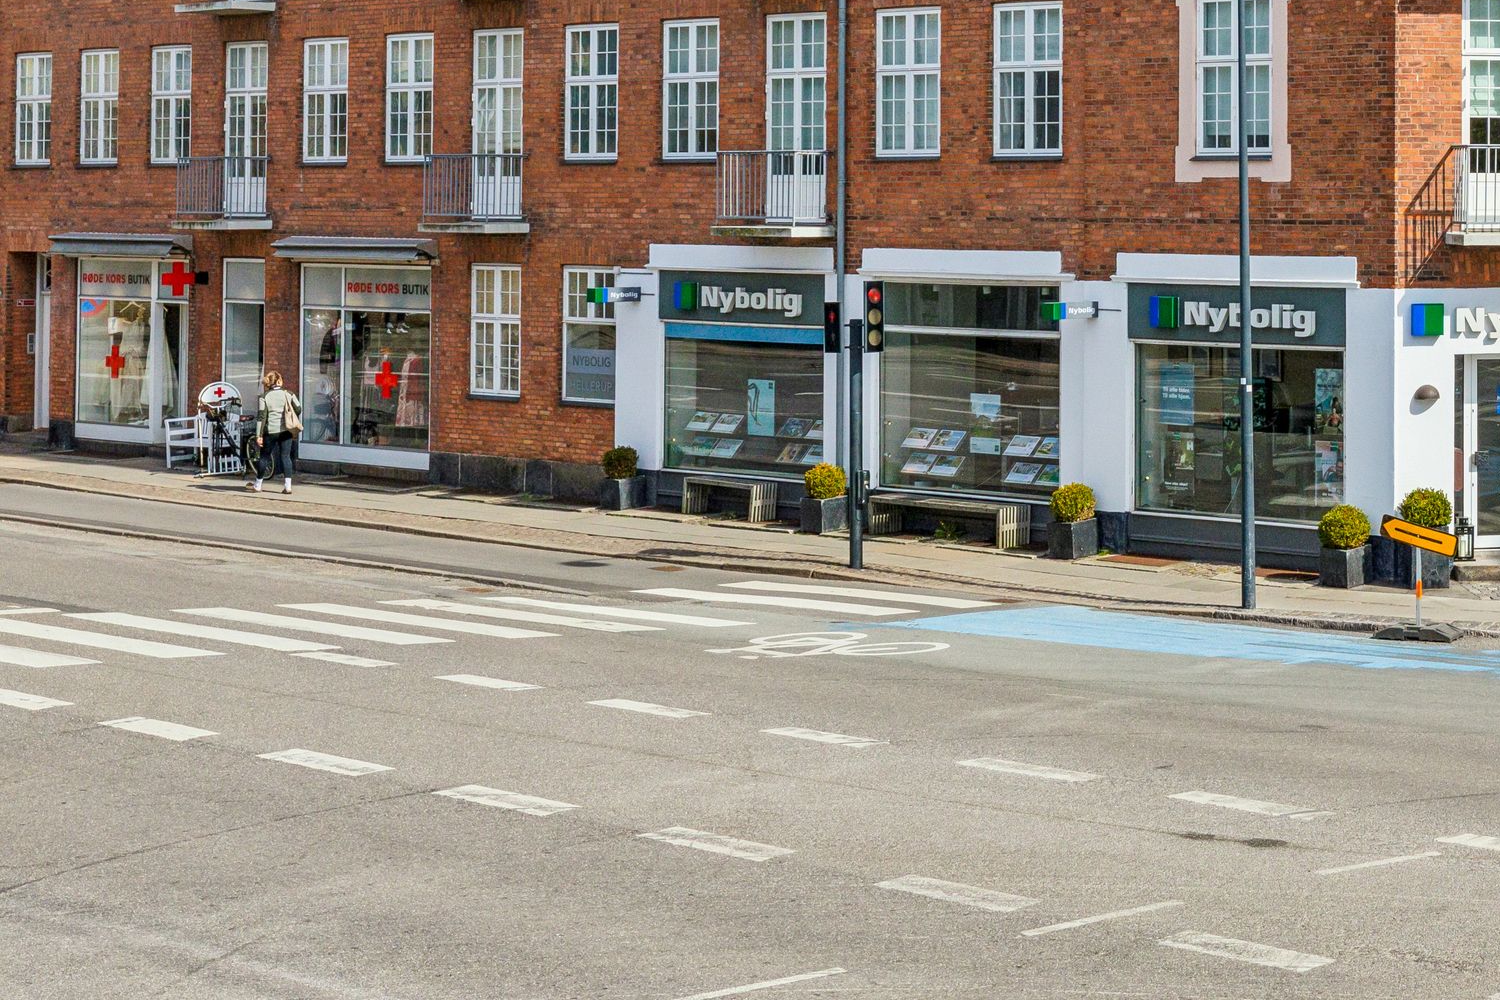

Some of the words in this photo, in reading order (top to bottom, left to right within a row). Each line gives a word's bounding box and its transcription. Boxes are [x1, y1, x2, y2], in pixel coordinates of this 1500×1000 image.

[82, 273, 104, 283] RØDE
[106, 273, 126, 284] KORS
[128, 274, 151, 285] BUTIK
[347, 282, 373, 293] RØDE
[375, 282, 400, 294] KORS
[402, 284, 429, 295] BUTIK
[610, 290, 638, 299] Nybolig
[701, 285, 803, 317] Nybolig
[1068, 306, 1096, 315] Nybolig
[572, 355, 612, 368] NYBOLIG
